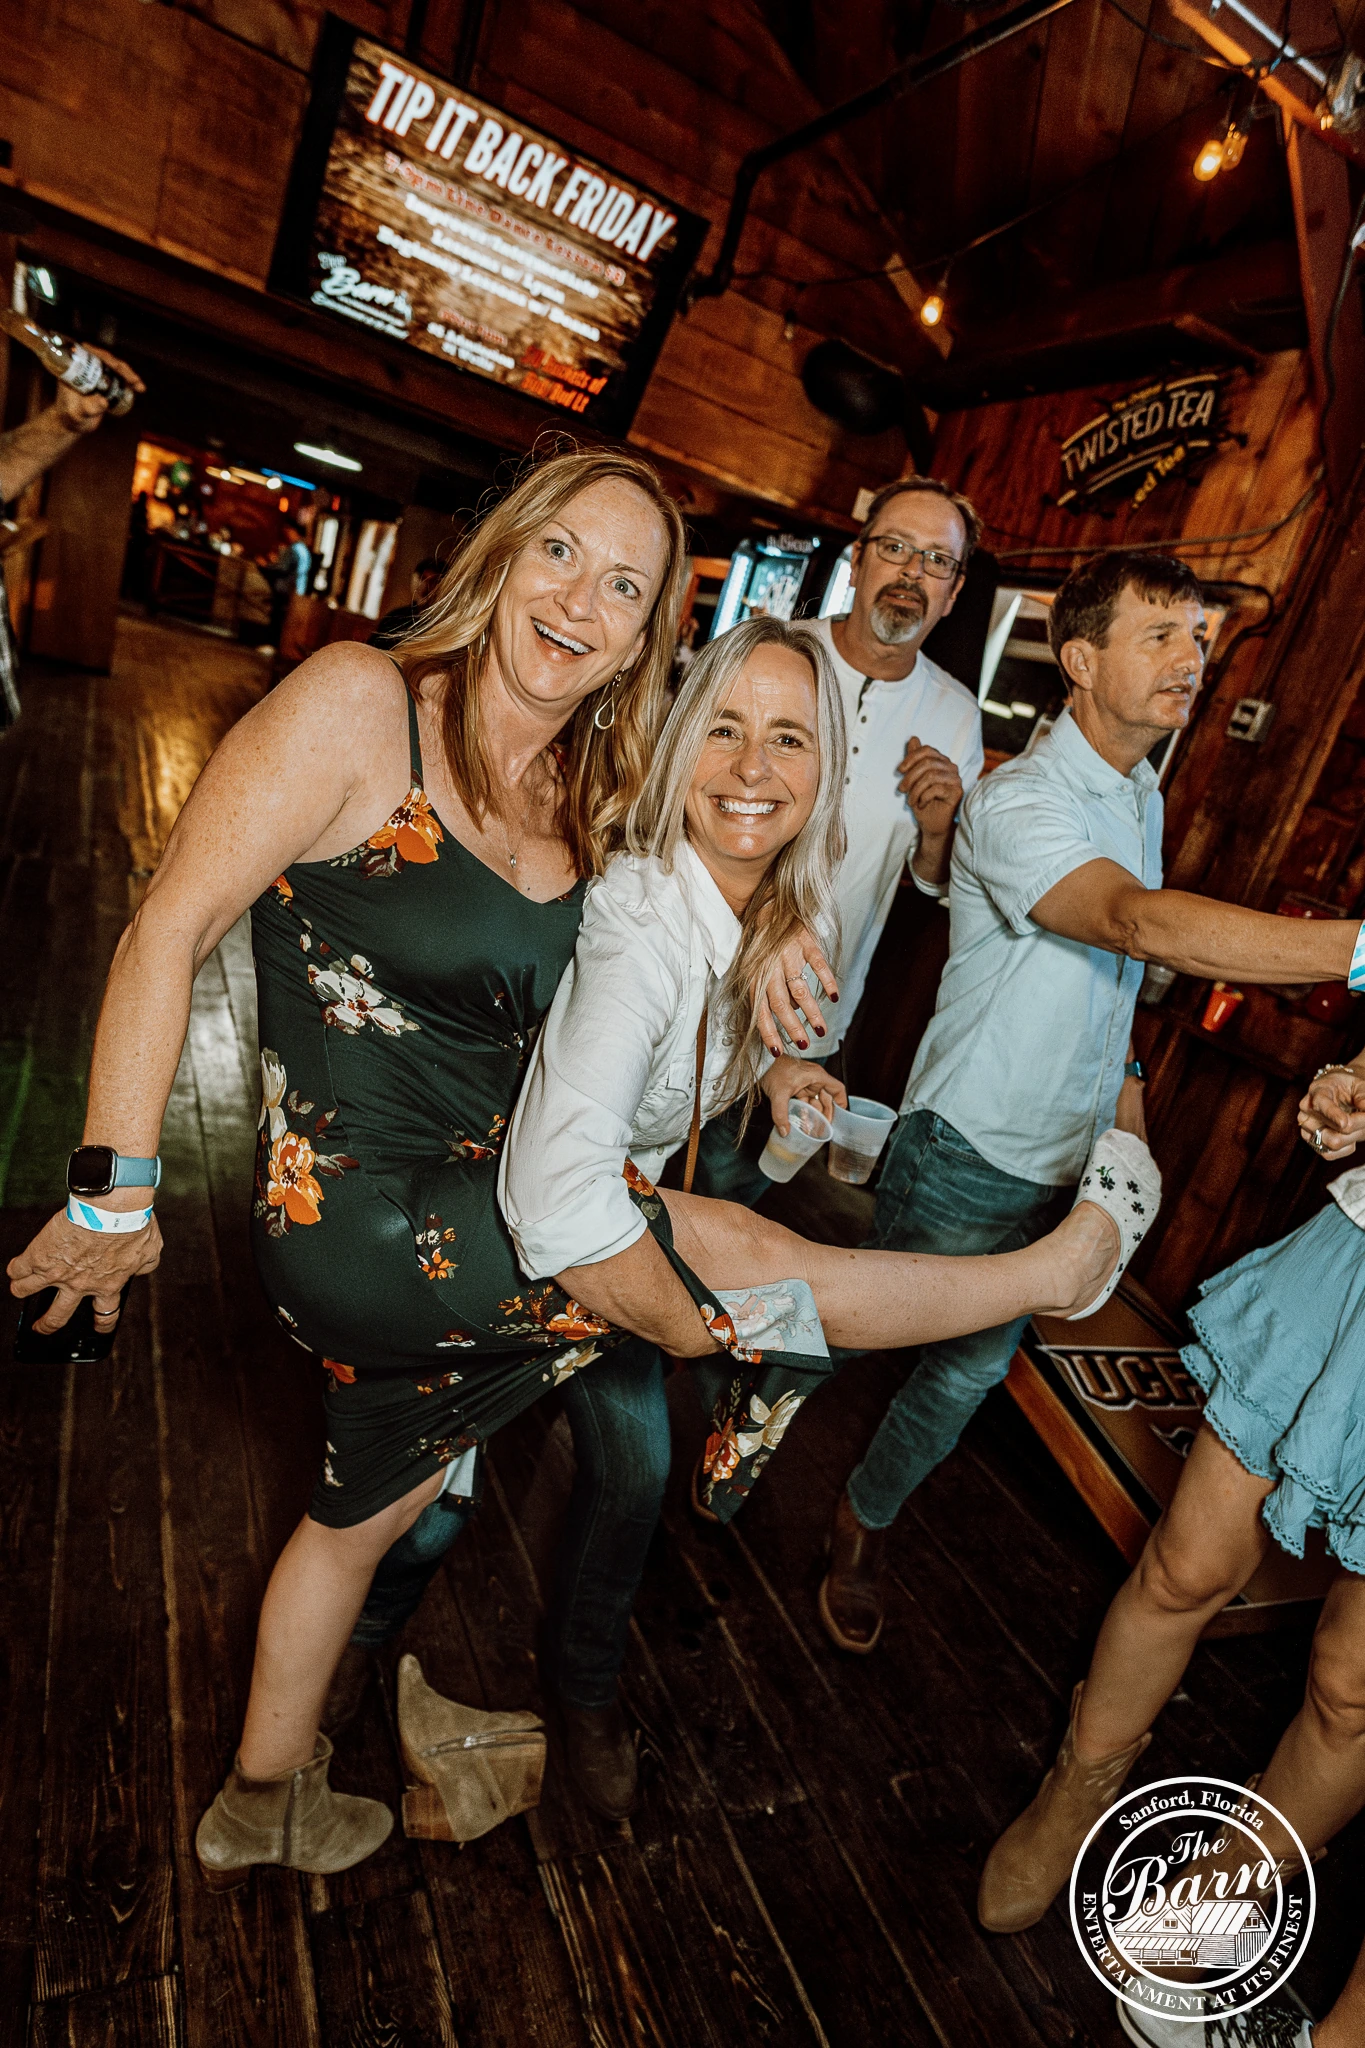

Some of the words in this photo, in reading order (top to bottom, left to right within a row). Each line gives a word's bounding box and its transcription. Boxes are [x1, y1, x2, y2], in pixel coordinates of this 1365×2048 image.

[366, 61, 435, 136] TIP
[425, 98, 478, 160] IT
[464, 119, 568, 208] BACK
[553, 166, 676, 260] FRIDAY
[1061, 401, 1164, 480] TWISTED
[1167, 390, 1215, 428] TEA
